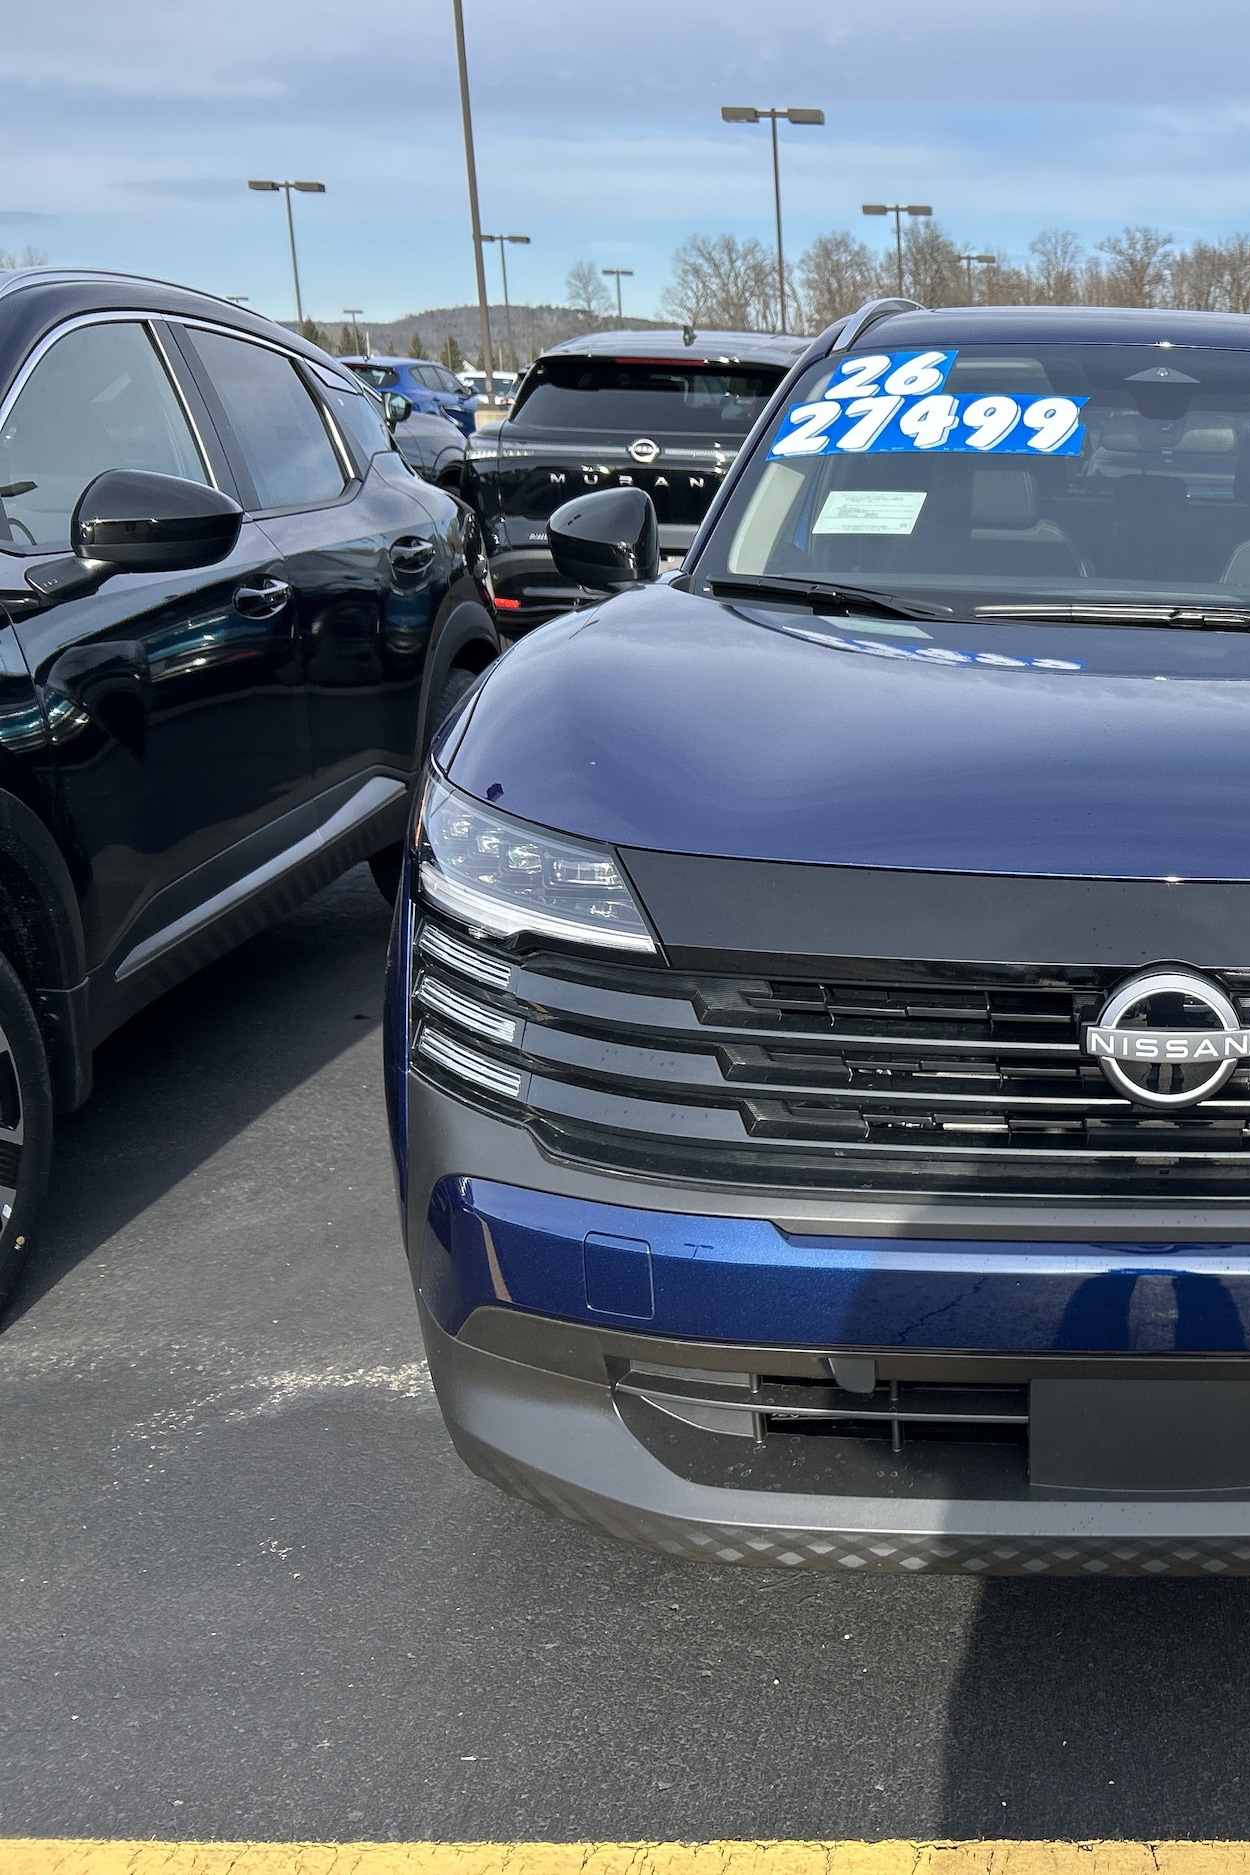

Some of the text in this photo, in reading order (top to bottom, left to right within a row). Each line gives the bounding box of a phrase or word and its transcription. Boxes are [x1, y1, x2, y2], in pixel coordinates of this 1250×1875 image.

[825, 351, 948, 399] 26
[772, 394, 1082, 455] 27499
[550, 472, 705, 488] MURAN
[1090, 1032, 1248, 1059] NISSAN
